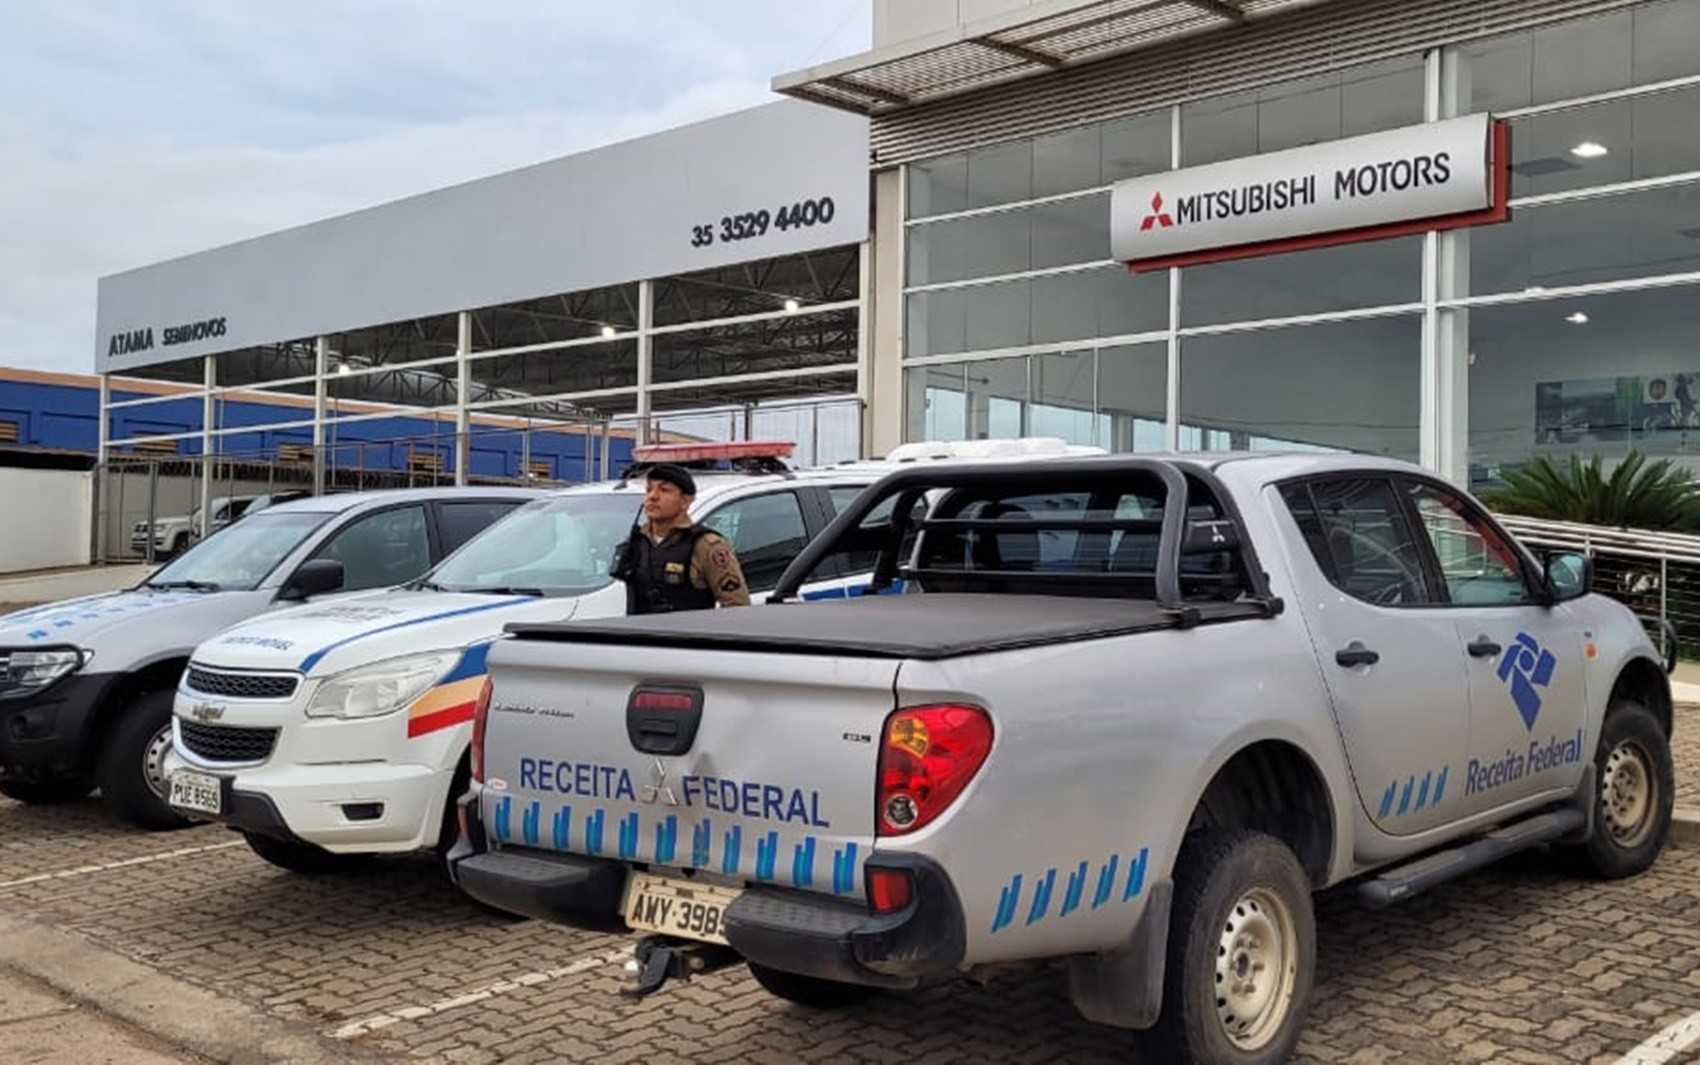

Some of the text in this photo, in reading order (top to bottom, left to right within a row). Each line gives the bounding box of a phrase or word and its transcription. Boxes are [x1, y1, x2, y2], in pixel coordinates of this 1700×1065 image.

[691, 196, 835, 247] 35 3529 4400
[1177, 152, 1450, 225] MITSUBISHI MOTORS
[108, 316, 227, 357] ATAMA SEMINOVOS
[520, 757, 830, 828] RECEITA FEDERAL
[1464, 727, 1583, 797] Receita Federal
